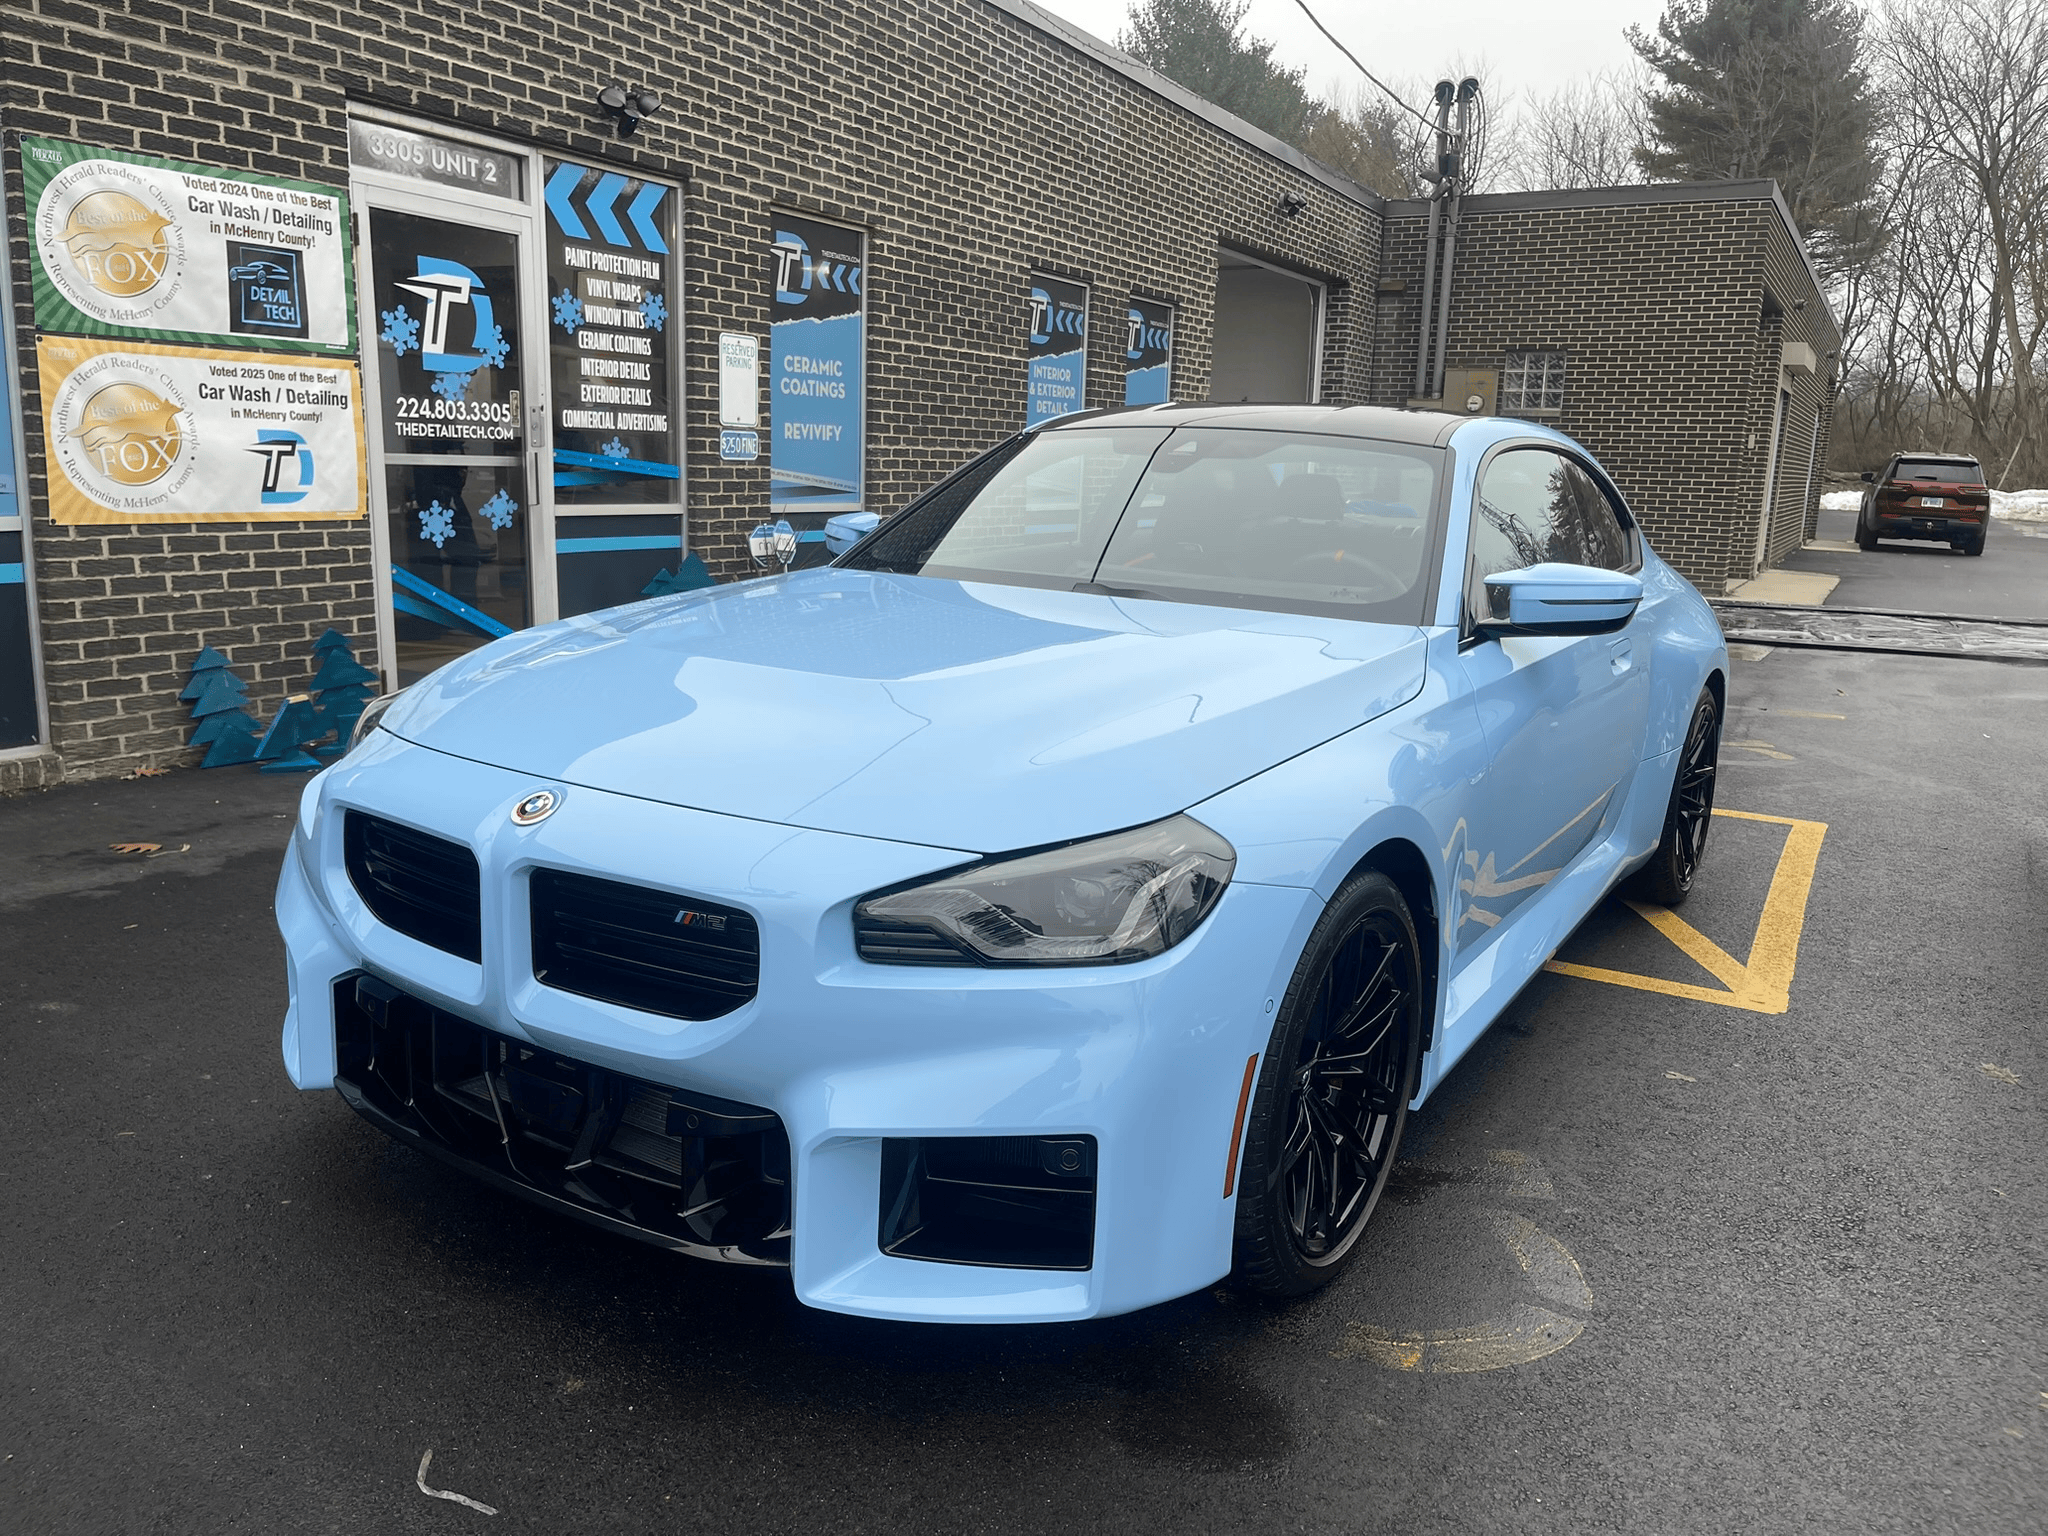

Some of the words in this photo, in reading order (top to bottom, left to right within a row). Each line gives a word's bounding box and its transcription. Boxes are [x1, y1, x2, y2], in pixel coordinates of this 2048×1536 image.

[370, 134, 424, 165] 3305
[432, 148, 479, 177] UNIT
[485, 162, 497, 182] 2
[182, 176, 217, 192] Voted
[220, 182, 248, 197] 2024
[251, 187, 273, 200] One
[276, 192, 287, 203] of
[290, 193, 308, 206] the
[310, 196, 332, 210] Best
[43, 189, 63, 247] Northwest
[60, 165, 94, 190] Herald
[149, 184, 176, 221] Choice
[173, 226, 187, 266] Awards
[188, 195, 214, 214] Car
[218, 200, 260, 221] Wash
[264, 207, 268, 224] /
[272, 208, 332, 236] Detailing
[210, 220, 220, 234] in
[224, 222, 274, 244] McHenry
[278, 230, 316, 250] County!
[81, 251, 164, 286] FOX
[565, 246, 591, 268] PAINT
[592, 251, 640, 278] PROTECTION
[642, 260, 660, 280] FILM
[50, 263, 107, 319] Representing
[109, 306, 154, 320] McHenry
[154, 280, 182, 310] County
[250, 286, 291, 304] DETAIL
[587, 278, 612, 299] VINYL
[612, 282, 642, 303] WRAPS
[264, 304, 295, 320] TECH
[584, 304, 622, 326] WINDOW
[622, 310, 645, 330] TINTS
[578, 330, 614, 352] CERAMIC
[614, 334, 652, 356] COATINGS
[722, 342, 754, 358] RESERVED
[209, 365, 238, 377] Voted
[240, 368, 265, 379] 2025
[268, 370, 286, 380] One
[288, 371, 296, 382] of
[300, 372, 314, 382] the
[317, 373, 336, 384] Best
[581, 357, 618, 378] INTERIOR
[620, 361, 650, 381] DETAILS
[726, 356, 752, 370] PARKING
[784, 354, 842, 377] CERAMIC
[1034, 364, 1071, 382] INTERIOR
[198, 382, 225, 400] Car
[228, 385, 270, 402] Wash
[276, 388, 281, 403] /
[286, 388, 348, 410] Detailing
[581, 384, 620, 404] EXTERIOR
[621, 387, 652, 406] DETAILS
[780, 378, 845, 399] COATINGS
[1030, 382, 1036, 396] &
[1037, 382, 1076, 400] EXTERIOR
[57, 386, 77, 444] Northwest
[73, 359, 108, 385] Herald
[160, 374, 187, 408] Choice
[184, 411, 200, 451] Awards
[230, 408, 240, 418] in
[243, 408, 286, 422] McHenry
[290, 410, 322, 424] County!
[396, 397, 511, 422] 224.803.3305
[1036, 400, 1068, 414] DETAILS
[395, 422, 514, 440] THEDETAILTECH.COM
[562, 410, 615, 430] COMMERCIAL
[617, 412, 668, 432] ADVERTISING
[784, 422, 842, 441] REVIVIFY
[722, 437, 740, 454] $250
[741, 438, 758, 454] FINE
[97, 440, 174, 477] FOX
[66, 458, 120, 508] Representing
[124, 492, 169, 508] McHenry
[168, 464, 195, 494] County
